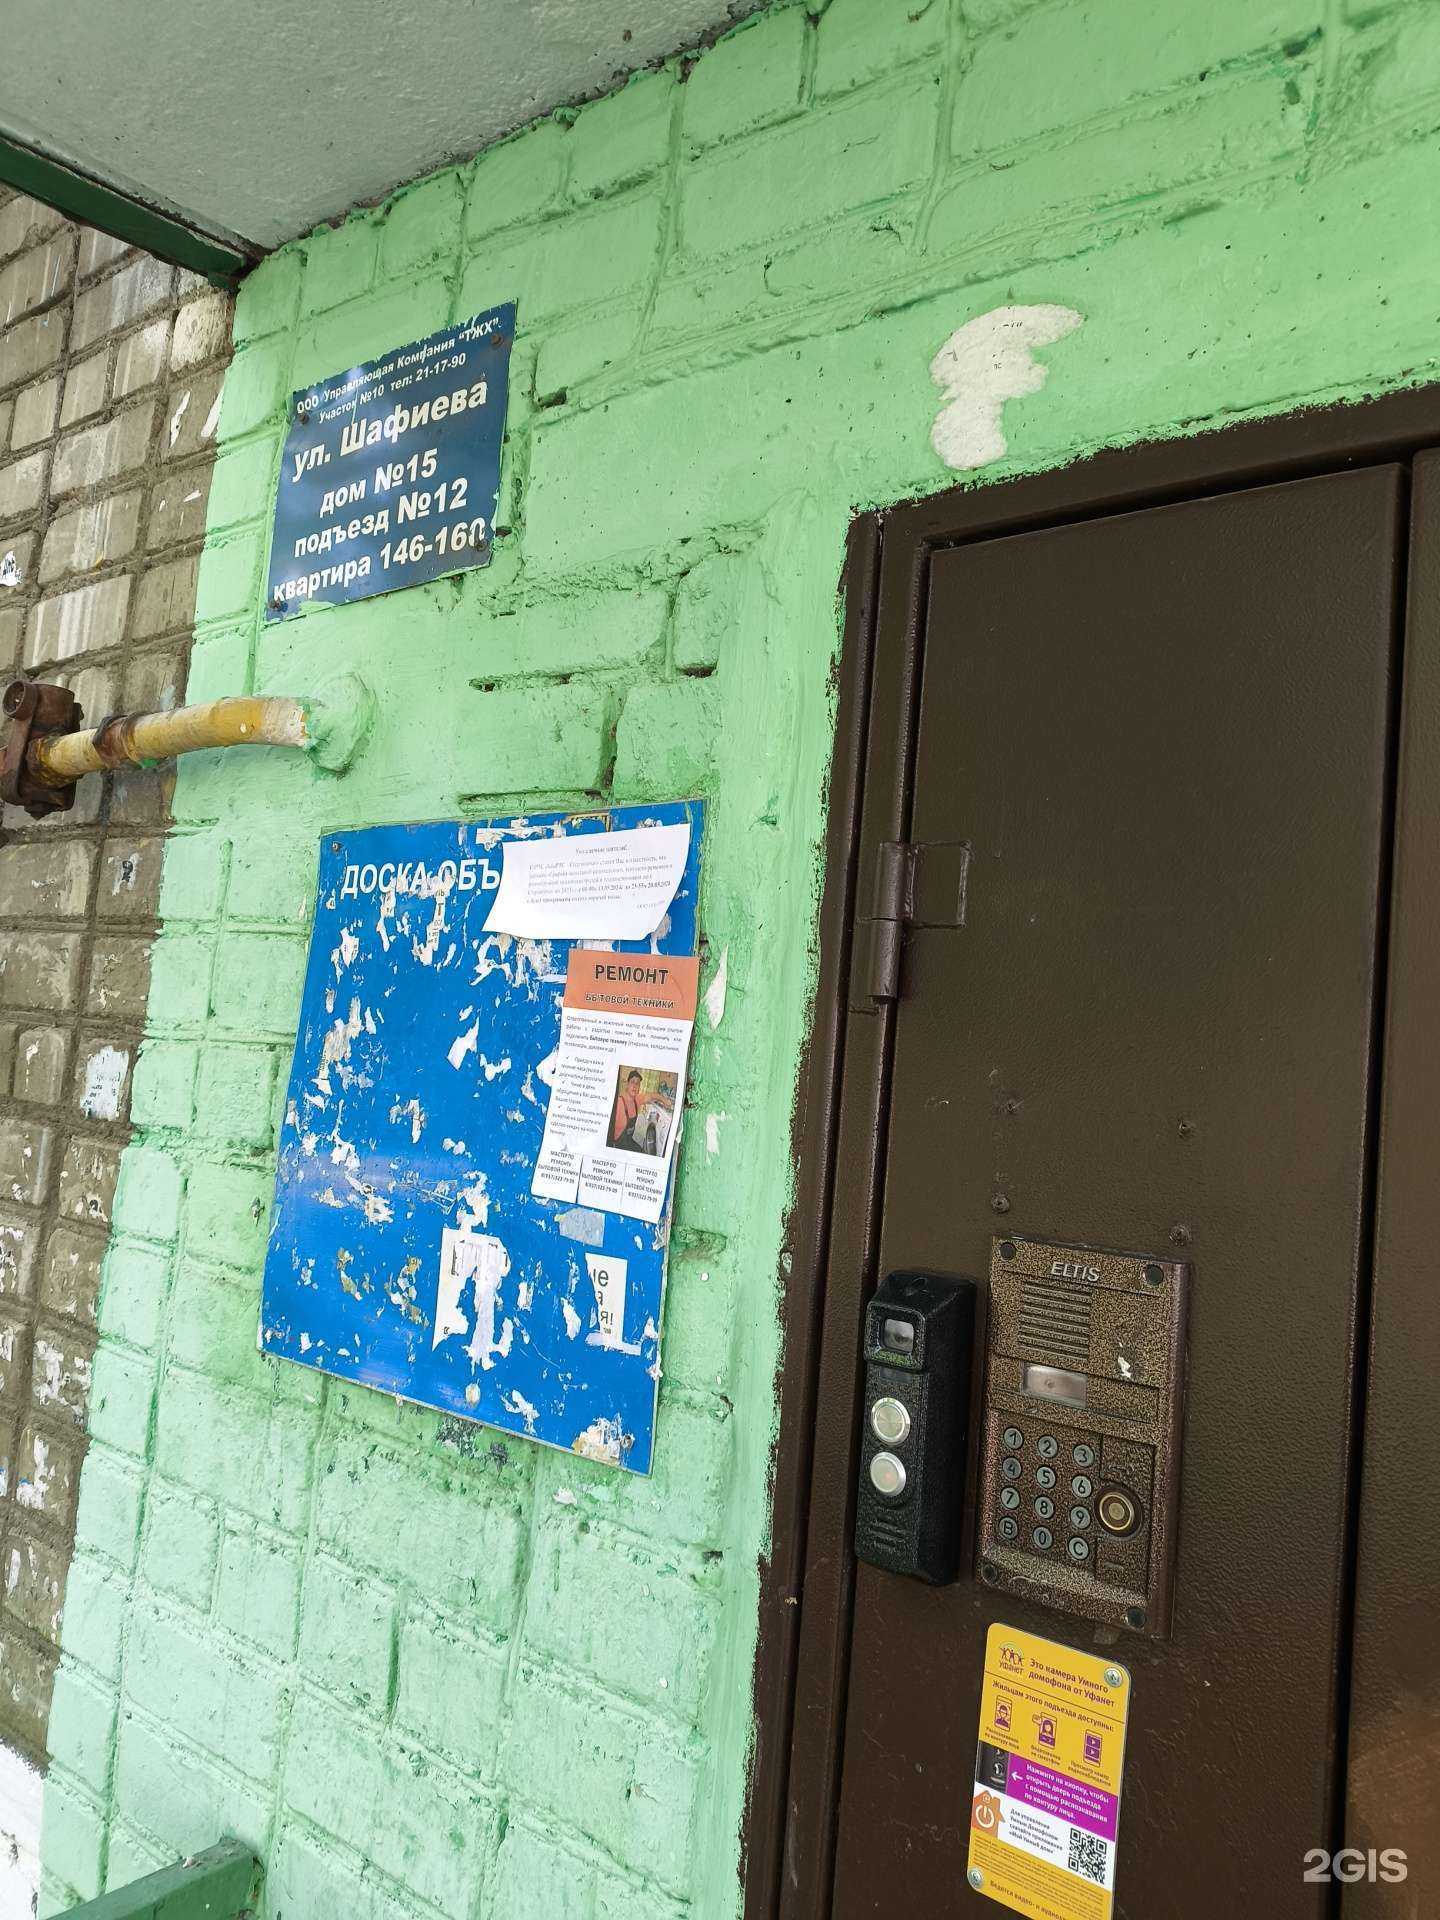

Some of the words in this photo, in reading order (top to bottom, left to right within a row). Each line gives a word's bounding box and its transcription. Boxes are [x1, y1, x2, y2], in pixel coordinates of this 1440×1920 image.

[297, 395, 319, 413] ООО
[323, 363, 394, 402] Управляющая
[397, 338, 456, 369] Компания
[319, 400, 357, 424] Участок
[360, 385, 385, 405] №10
[390, 374, 413, 391] тел:
[415, 352, 466, 382] 21-17-90
[292, 445, 331, 483] ул.
[340, 381, 488, 456] Шафиева
[319, 478, 366, 518] дом
[374, 448, 438, 491] №15
[294, 509, 390, 558] подъезд
[397, 477, 469, 524] №12
[273, 555, 372, 602] квартира
[380, 517, 486, 570] 146-160
[340, 861, 429, 900] ДОСКА
[595, 964, 669, 985] РЕМОНТ
[585, 991, 629, 1005] БЫТОВОЙ
[632, 996, 675, 1009] ТЕХНИКИ
[592, 1159, 610, 1167] МАСТЕР
[1051, 1261, 1101, 1281] ELTIS
[1028, 1671, 1072, 1693] домофона
[1073, 1686, 1082, 1696] от
[1084, 1688, 1115, 1708] Уфанет
[1029, 1658, 1044, 1671] Это
[1046, 1664, 1076, 1683] камера
[1078, 1673, 1109, 1694] Умного
[992, 1680, 1024, 1698] Жильцам
[1025, 1693, 1043, 1705] этого
[1044, 1701, 1077, 1718] подъезда
[1077, 1714, 1115, 1732] доступны:
[1024, 1792, 1032, 1800] по
[1033, 1796, 1058, 1813] контуру
[1025, 1774, 1052, 1790] открыть
[1051, 1784, 1071, 1798] дверь
[1071, 1793, 1102, 1811] подъезда
[1026, 1764, 1055, 1781] Нажмите
[1055, 1777, 1064, 1785] на
[1064, 1780, 1089, 1796] кнопку,
[1089, 1790, 1109, 1804] чтобы
[1029, 1785, 1060, 1802] помощью
[1060, 1798, 1108, 1823] распознавания
